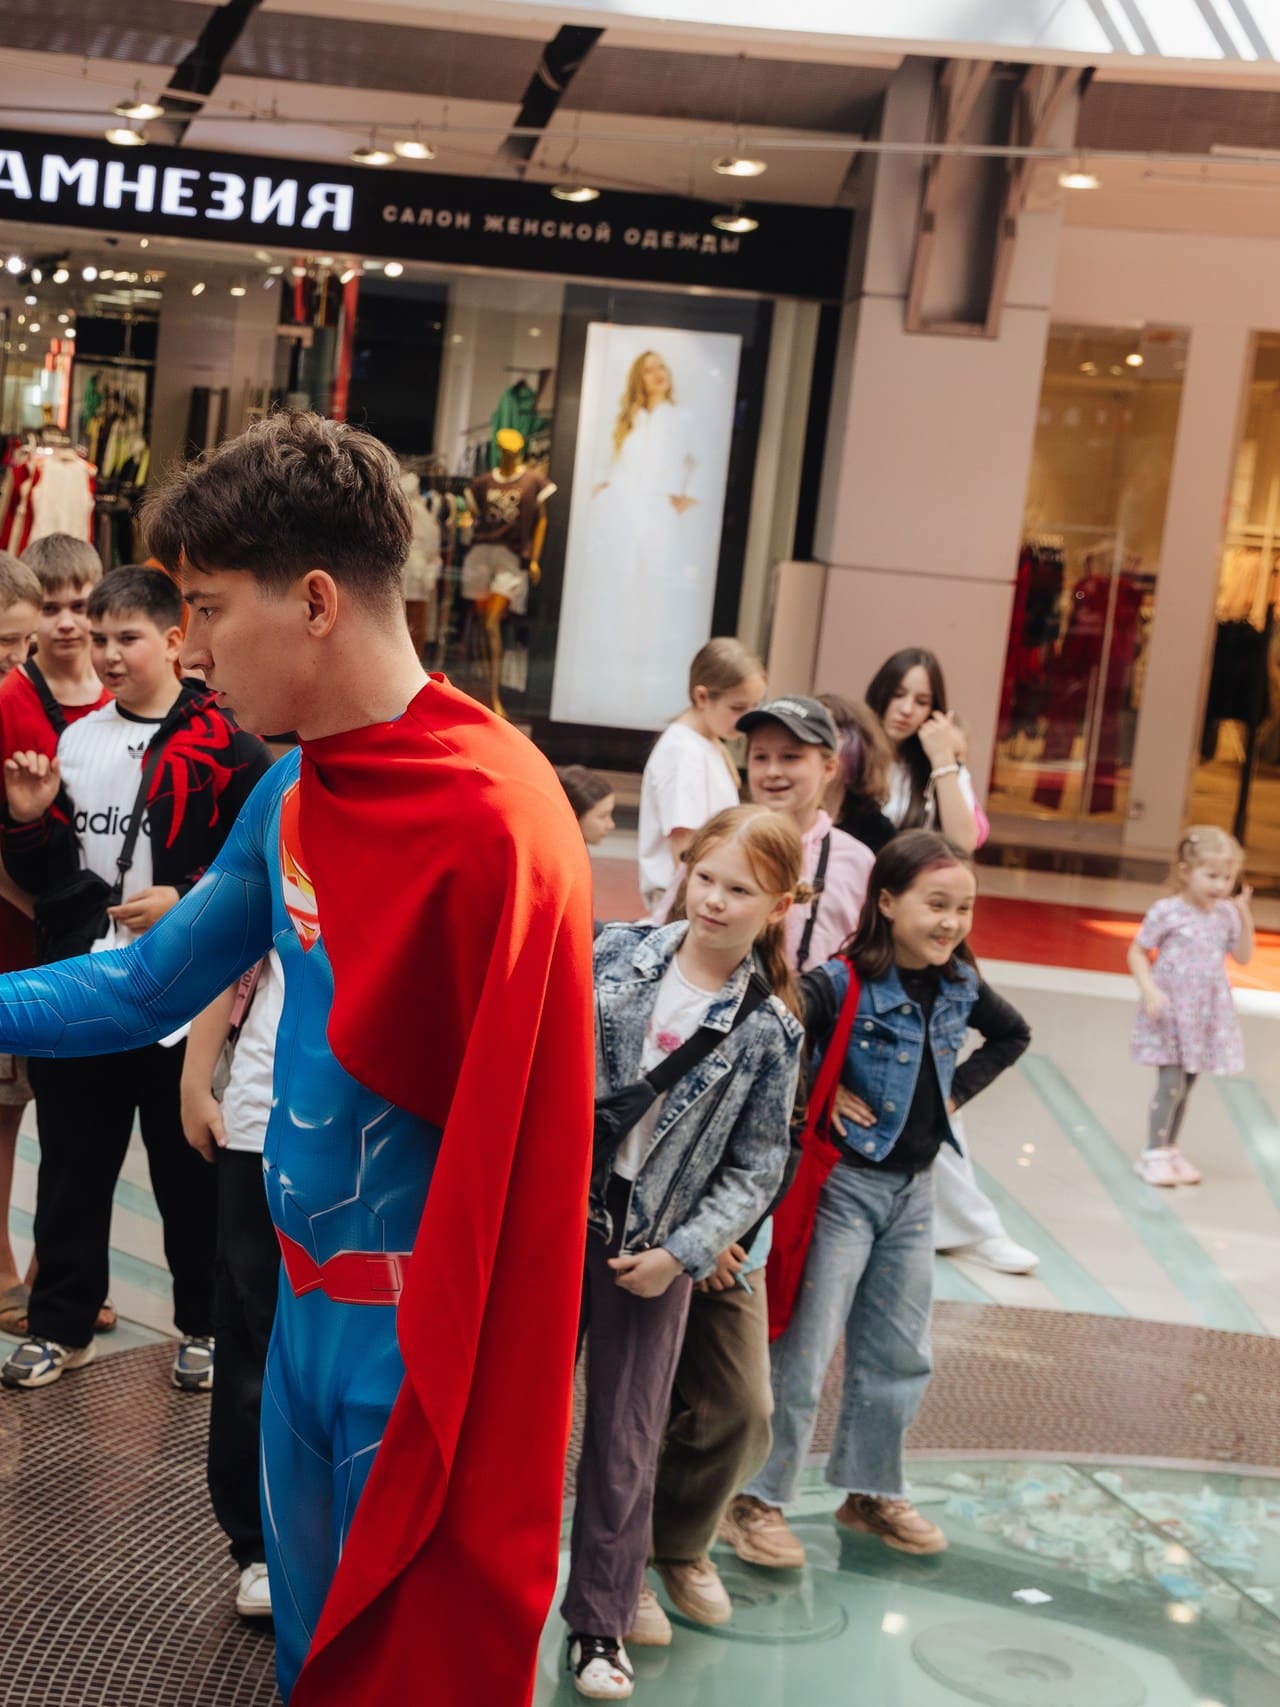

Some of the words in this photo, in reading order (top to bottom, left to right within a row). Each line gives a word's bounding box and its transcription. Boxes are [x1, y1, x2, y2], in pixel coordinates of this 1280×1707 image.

[382, 204, 471, 229] САЛОН
[483, 213, 611, 243] ЖЕНСКОЙ
[624, 227, 741, 254] ОДЕЖДЫ
[75, 806, 152, 837] adi
